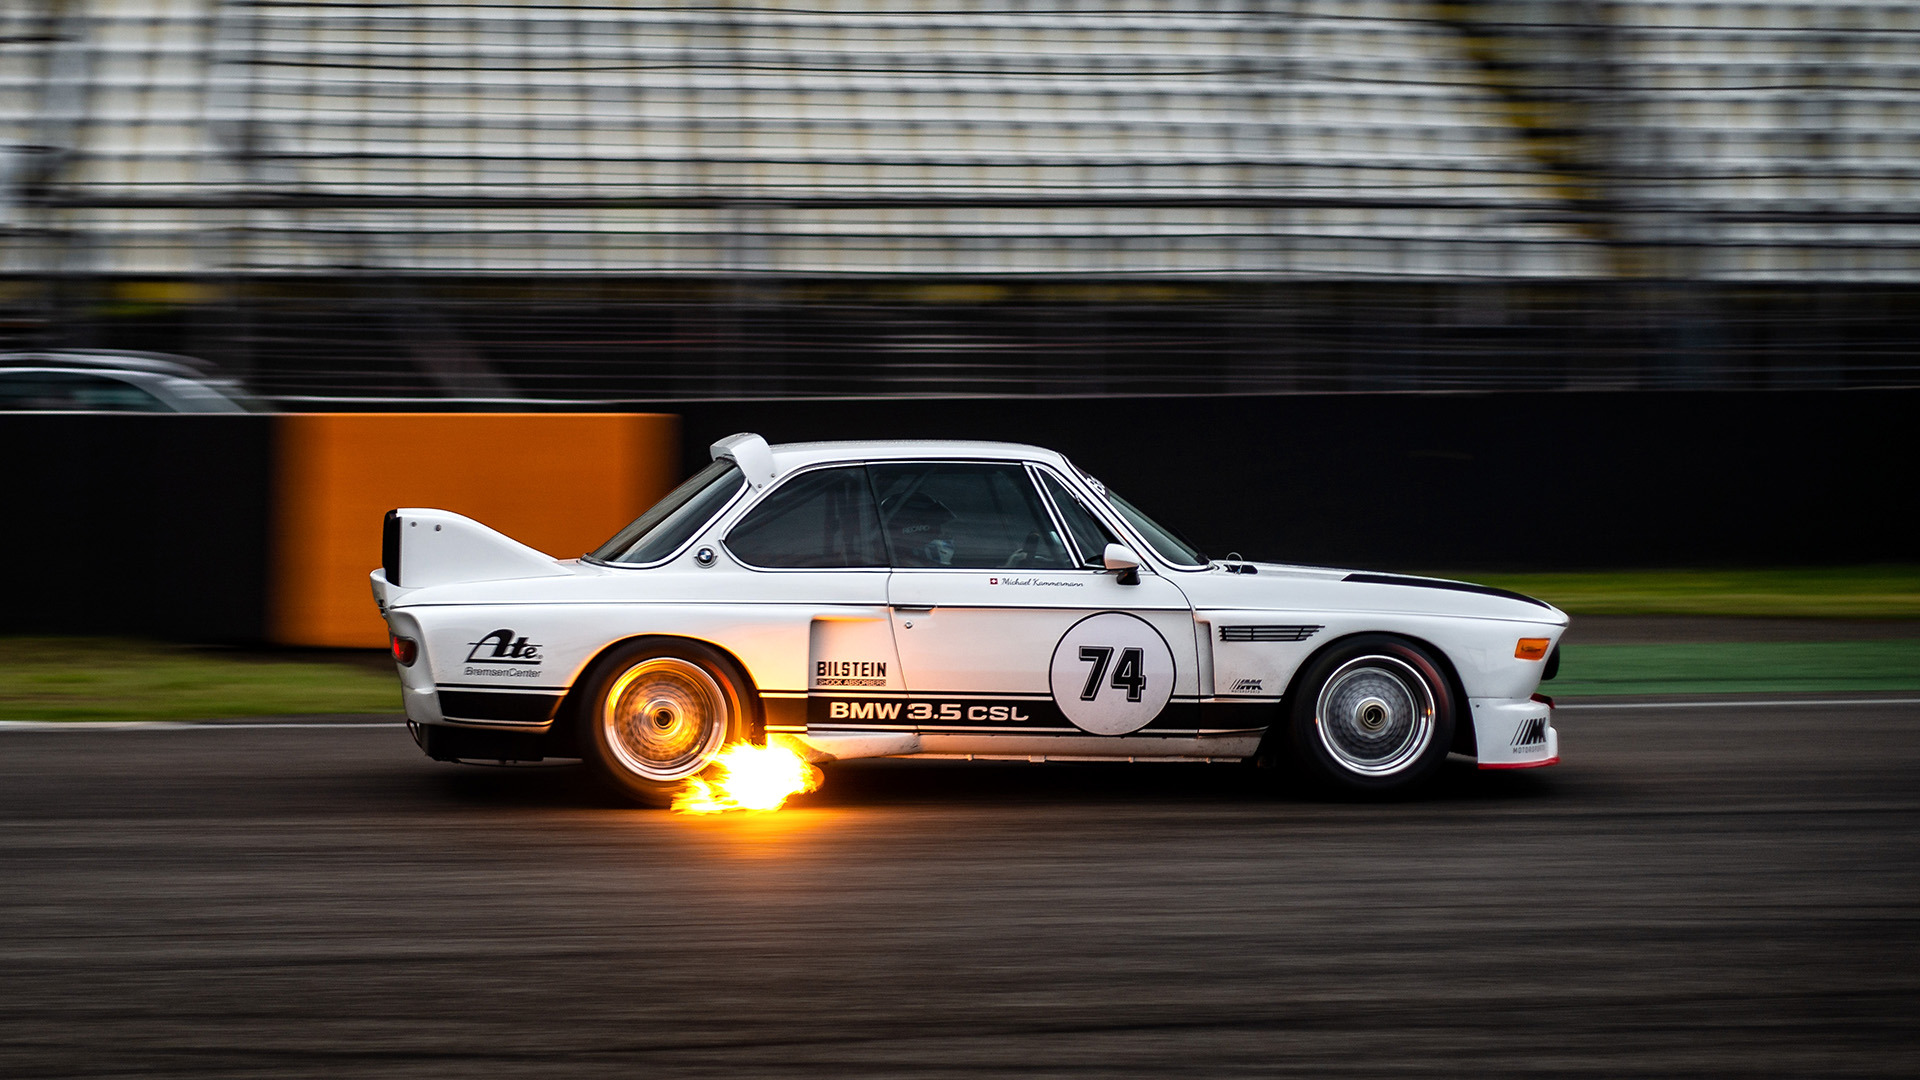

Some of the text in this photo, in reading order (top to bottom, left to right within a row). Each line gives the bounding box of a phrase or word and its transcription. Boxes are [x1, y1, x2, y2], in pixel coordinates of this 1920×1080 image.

[1002, 577, 1032, 586] Michael
[465, 629, 542, 664] Ate
[464, 667, 542, 678] BremsenCenter
[817, 661, 887, 677] BILSTEIN
[1079, 646, 1147, 702] 74
[830, 702, 1029, 721] BMW 3.5 CSL
